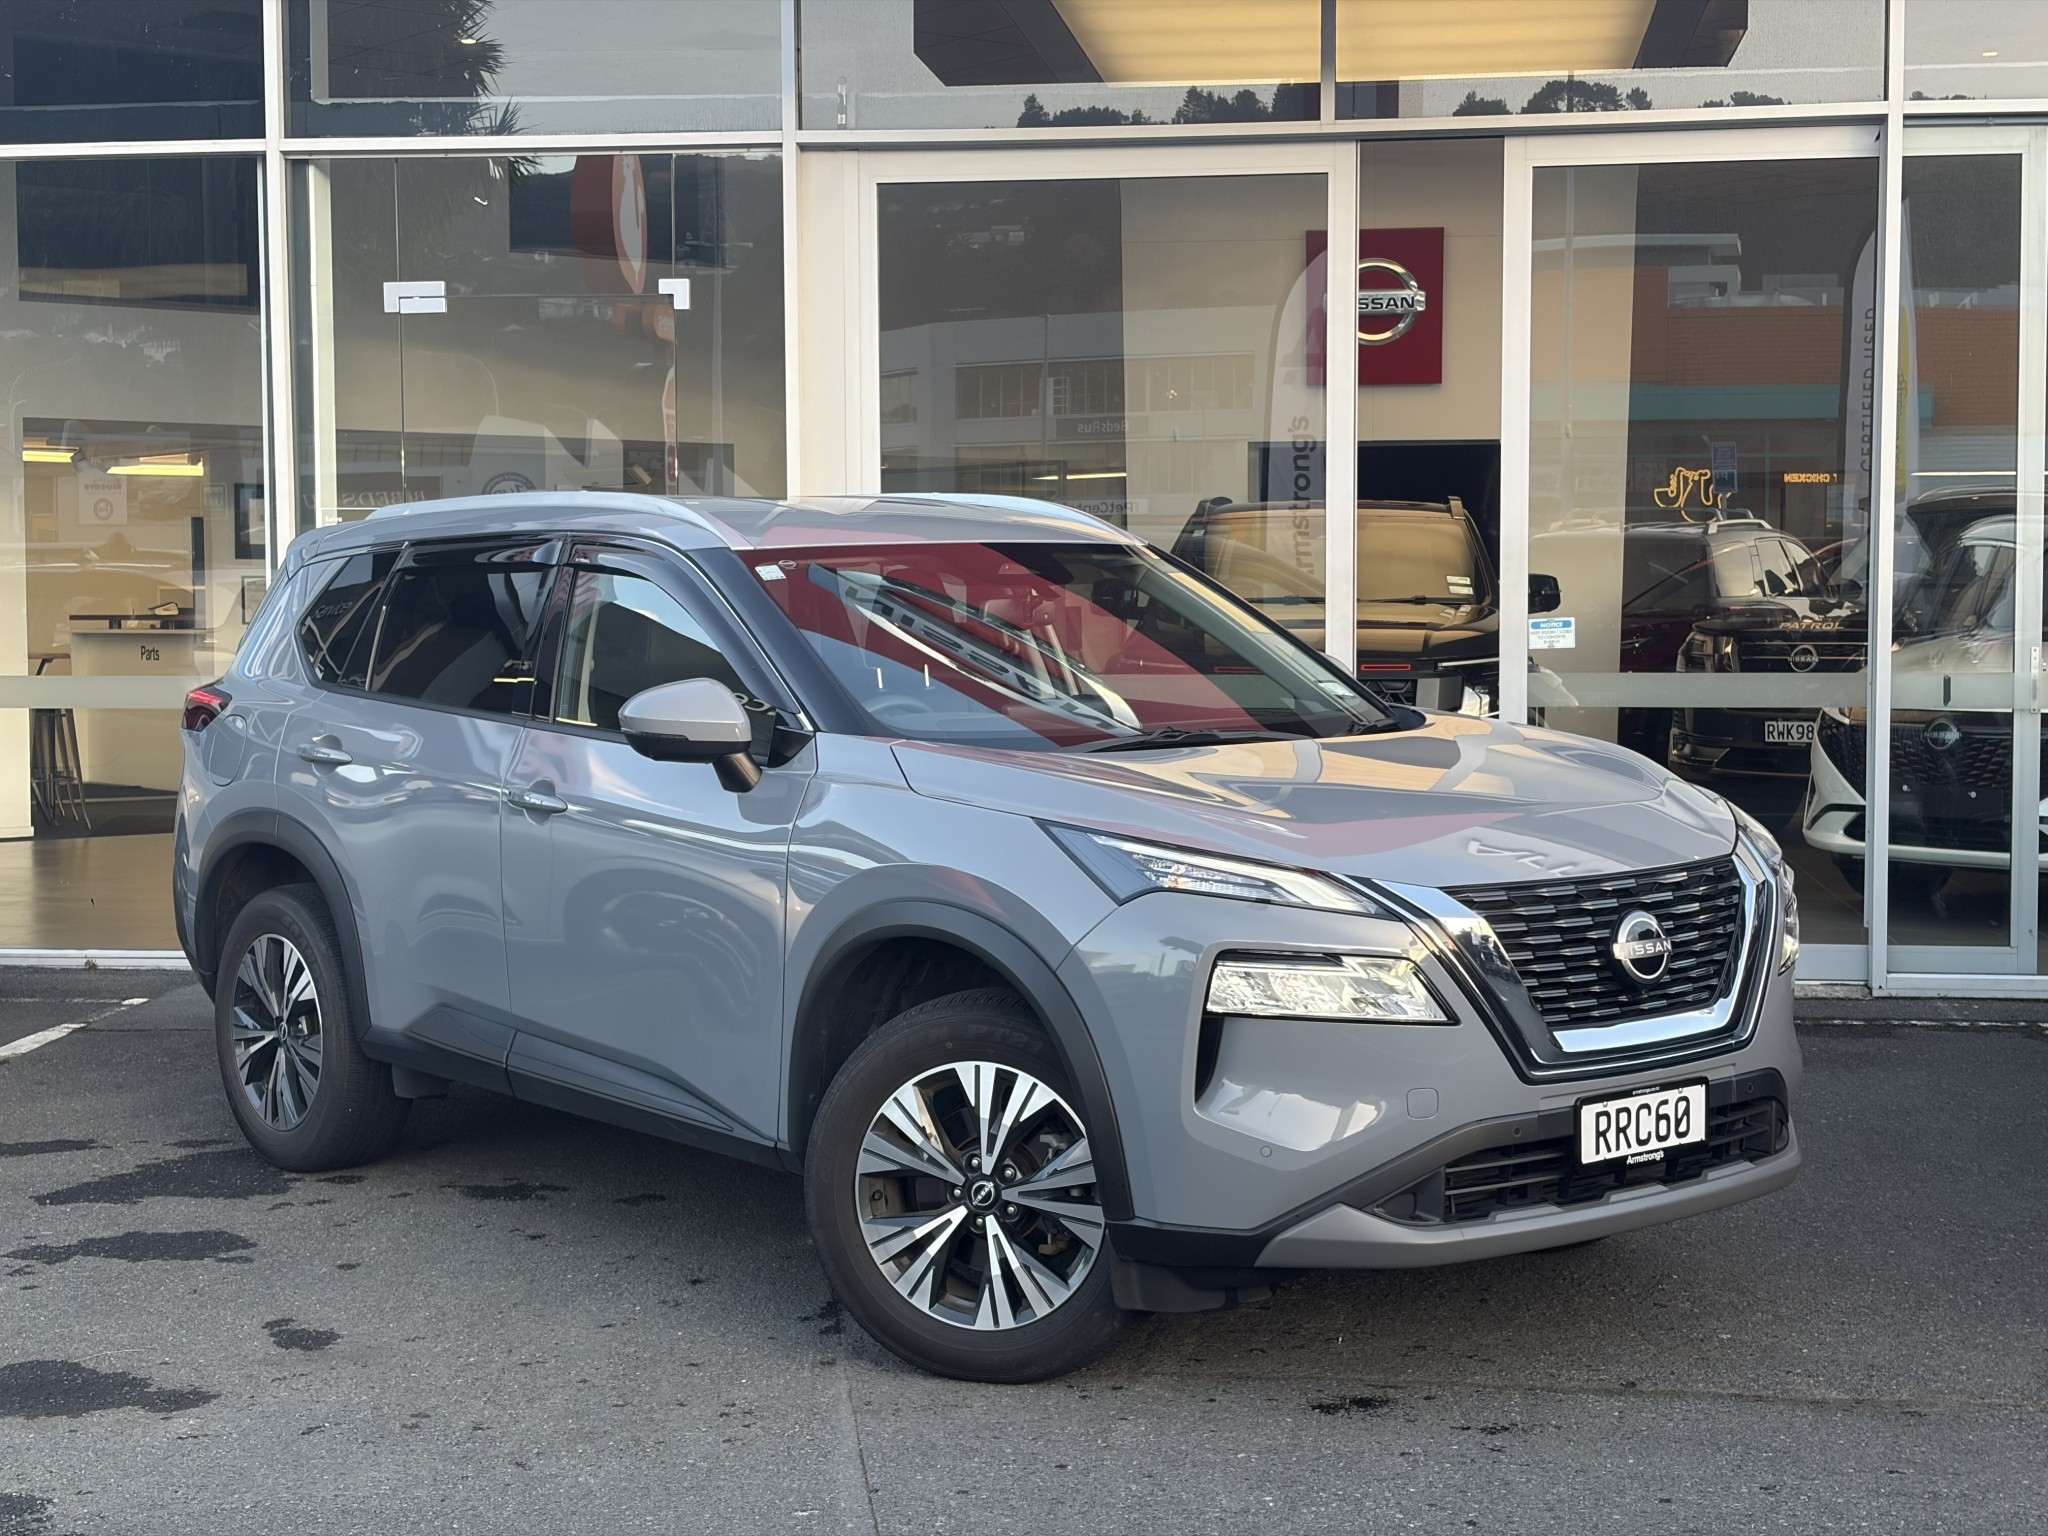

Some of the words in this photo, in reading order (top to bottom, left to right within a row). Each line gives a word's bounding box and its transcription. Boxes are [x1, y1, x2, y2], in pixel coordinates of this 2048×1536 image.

[1288, 416, 1317, 576] rmstrong's
[1779, 622, 1844, 630] PATROL
[140, 645, 160, 661] Parts
[1788, 655, 1819, 663] NISSAN
[1767, 723, 1814, 740] RWK98
[1595, 1095, 1690, 1156] RRC60
[1626, 1150, 1664, 1165] Armstrong's
[973, 1181, 994, 1206] NISSAN
